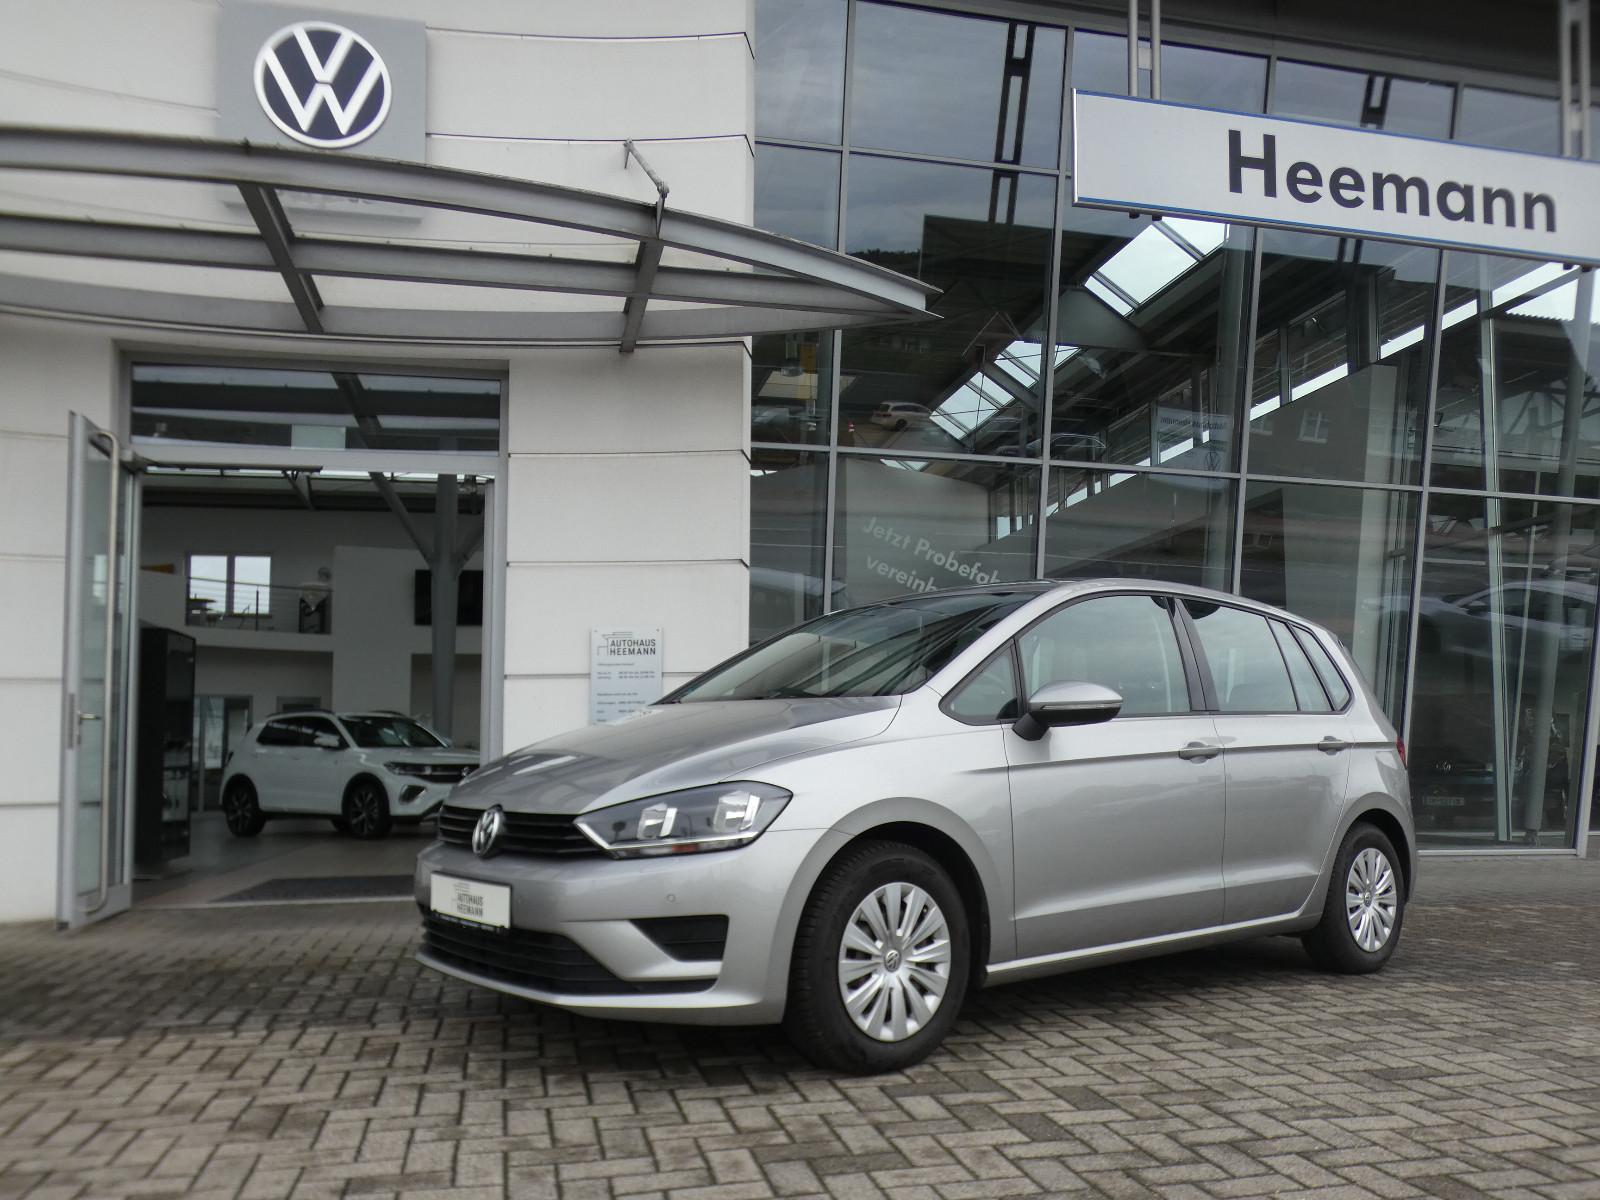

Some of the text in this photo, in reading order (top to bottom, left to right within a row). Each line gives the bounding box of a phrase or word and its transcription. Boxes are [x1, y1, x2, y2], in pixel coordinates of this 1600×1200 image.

[1229, 130, 1556, 232] Heemann
[863, 516, 912, 550] Jetzt
[610, 638, 656, 647] AUTOHAUS
[610, 647, 656, 656] HEEMANN
